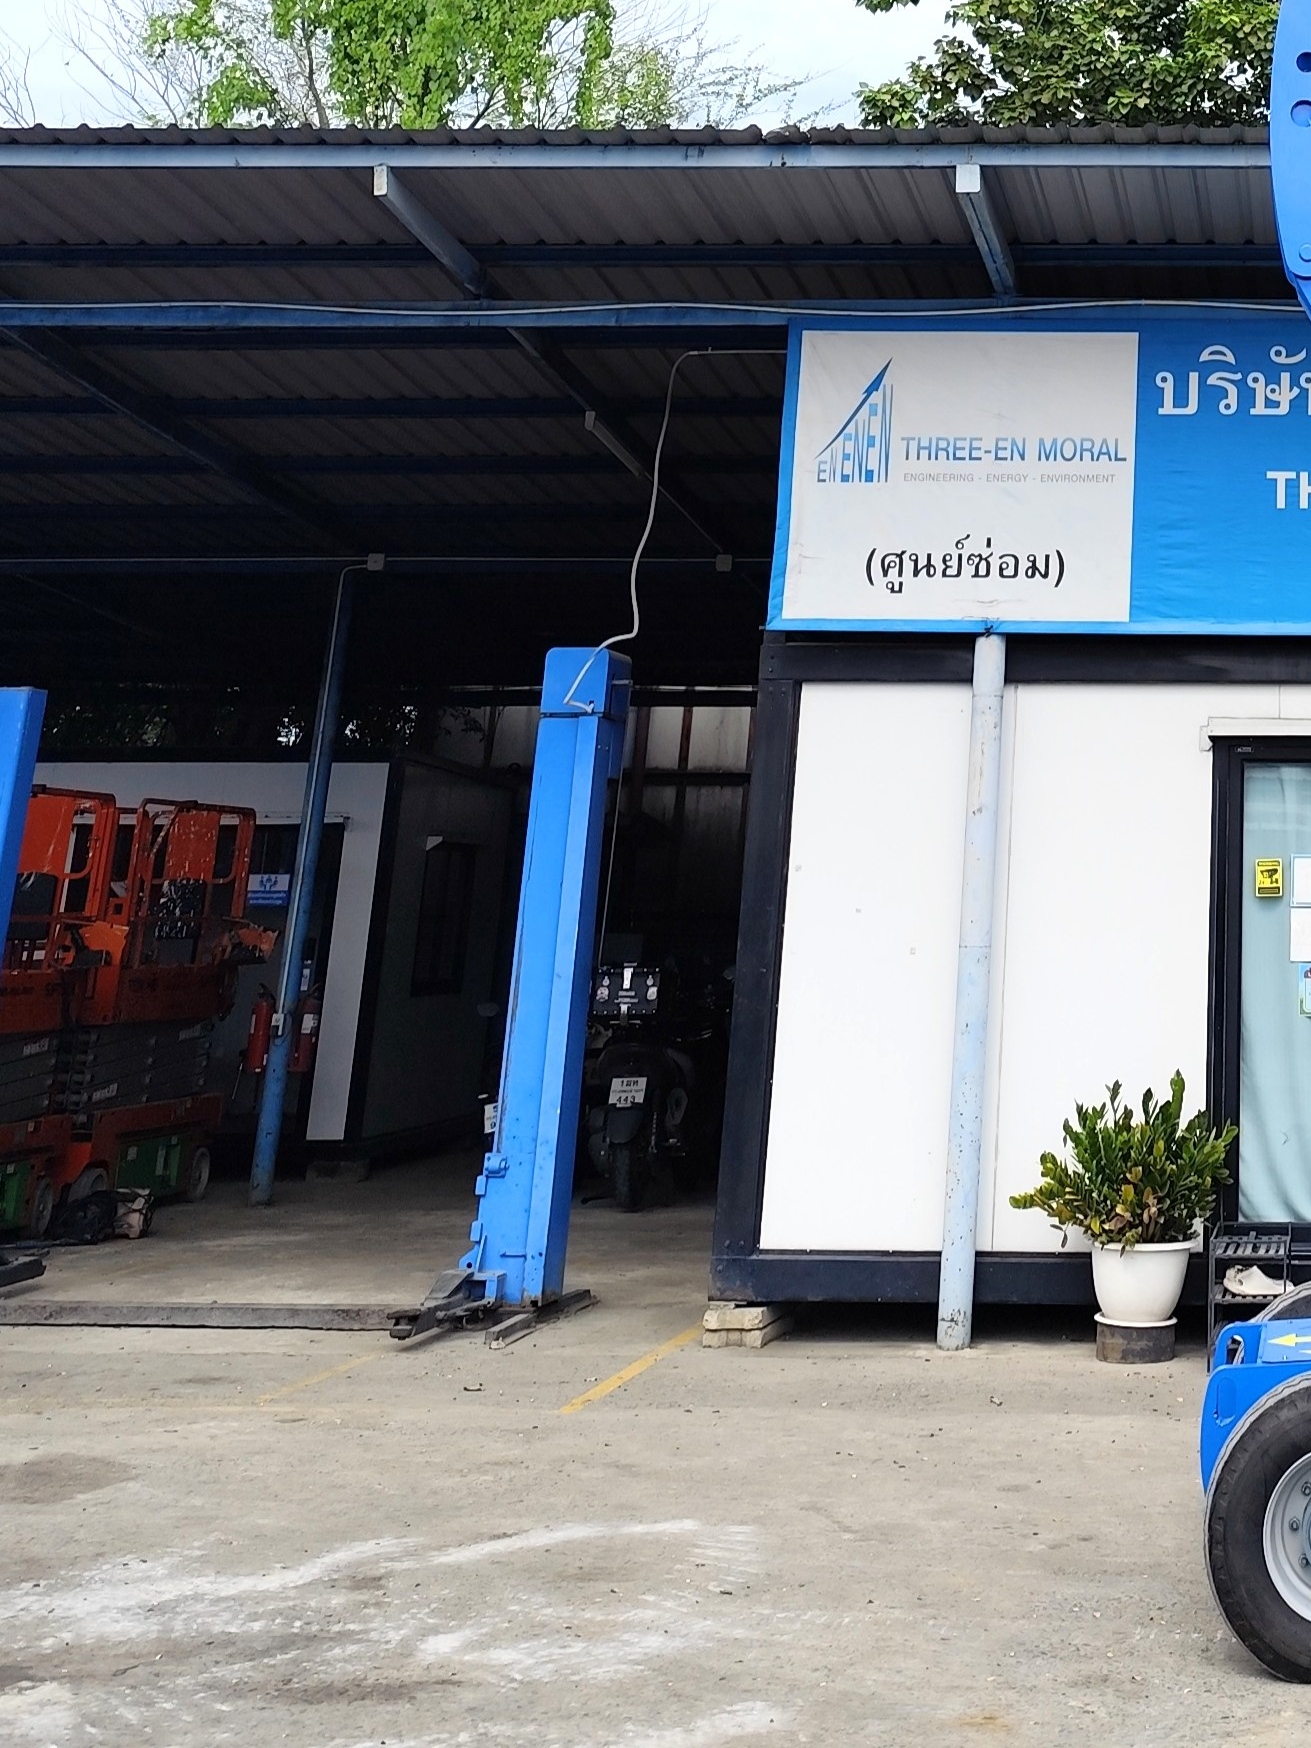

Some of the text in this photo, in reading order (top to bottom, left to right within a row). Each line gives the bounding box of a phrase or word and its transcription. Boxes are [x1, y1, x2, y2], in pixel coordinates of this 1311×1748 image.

[901, 437, 1127, 462] THREE-EN MORAL
[903, 473, 974, 483] ENGINEERING
[986, 474, 1029, 483] ENERGY
[1040, 474, 1116, 484] ENVIRONMENT
[865, 534, 1065, 594] (ศูนย์ซ่อม)
